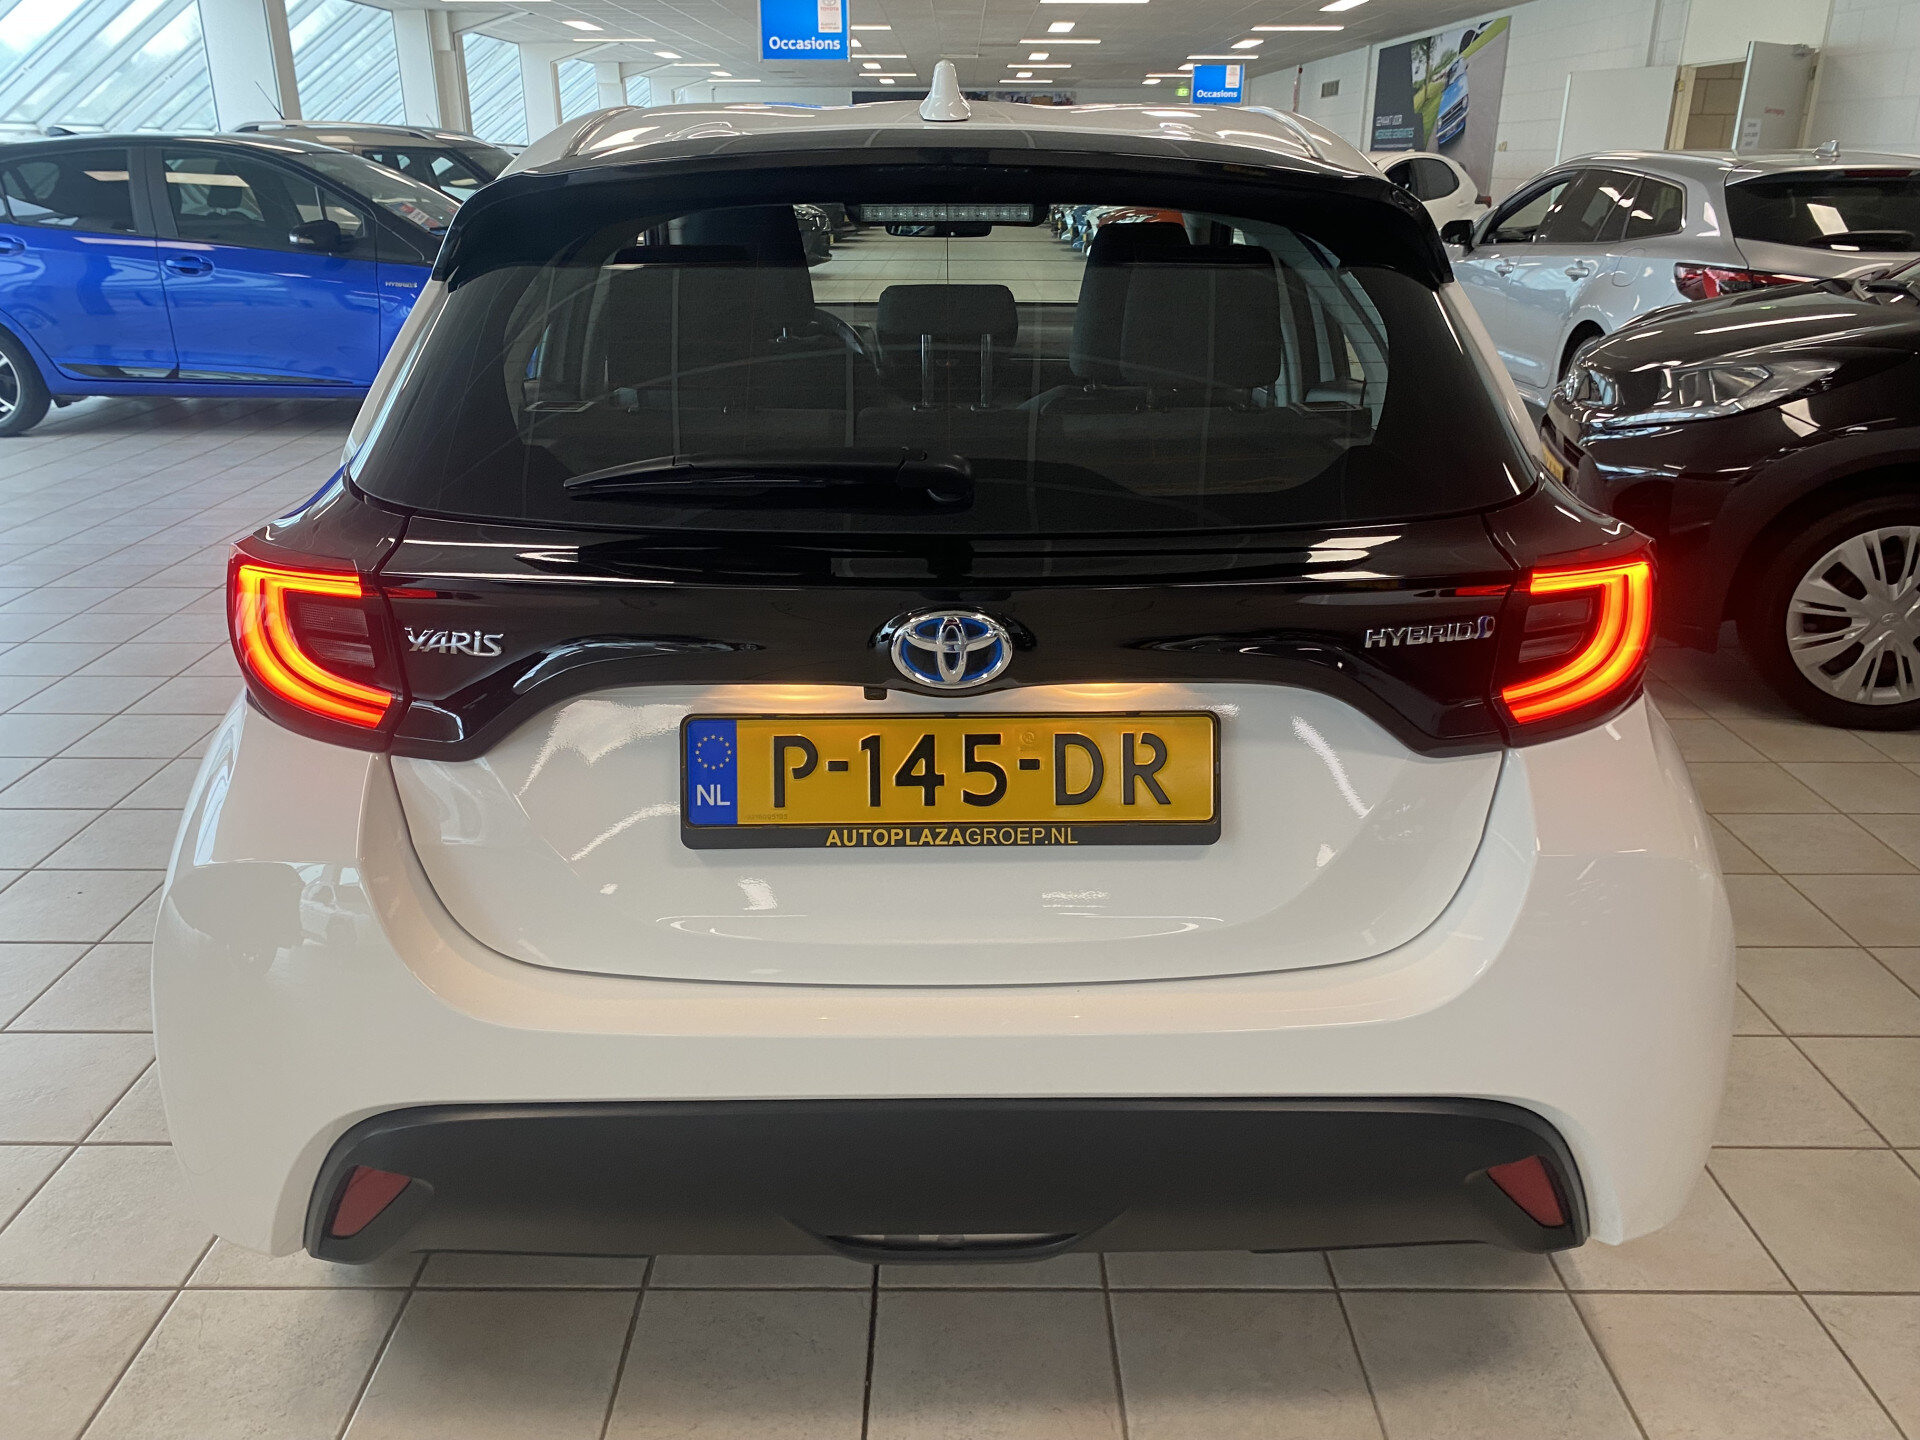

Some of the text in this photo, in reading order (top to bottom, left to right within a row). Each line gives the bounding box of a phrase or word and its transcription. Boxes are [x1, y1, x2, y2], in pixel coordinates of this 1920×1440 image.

[768, 36, 841, 50] Occasions
[1196, 89, 1238, 98] Occasions
[404, 626, 504, 657] YARIS
[1364, 621, 1474, 649] HYBRID
[773, 732, 1172, 807] P-145-DR
[696, 784, 731, 806] NL
[825, 828, 1078, 847] AUTOPLAZAGROEP.NL
